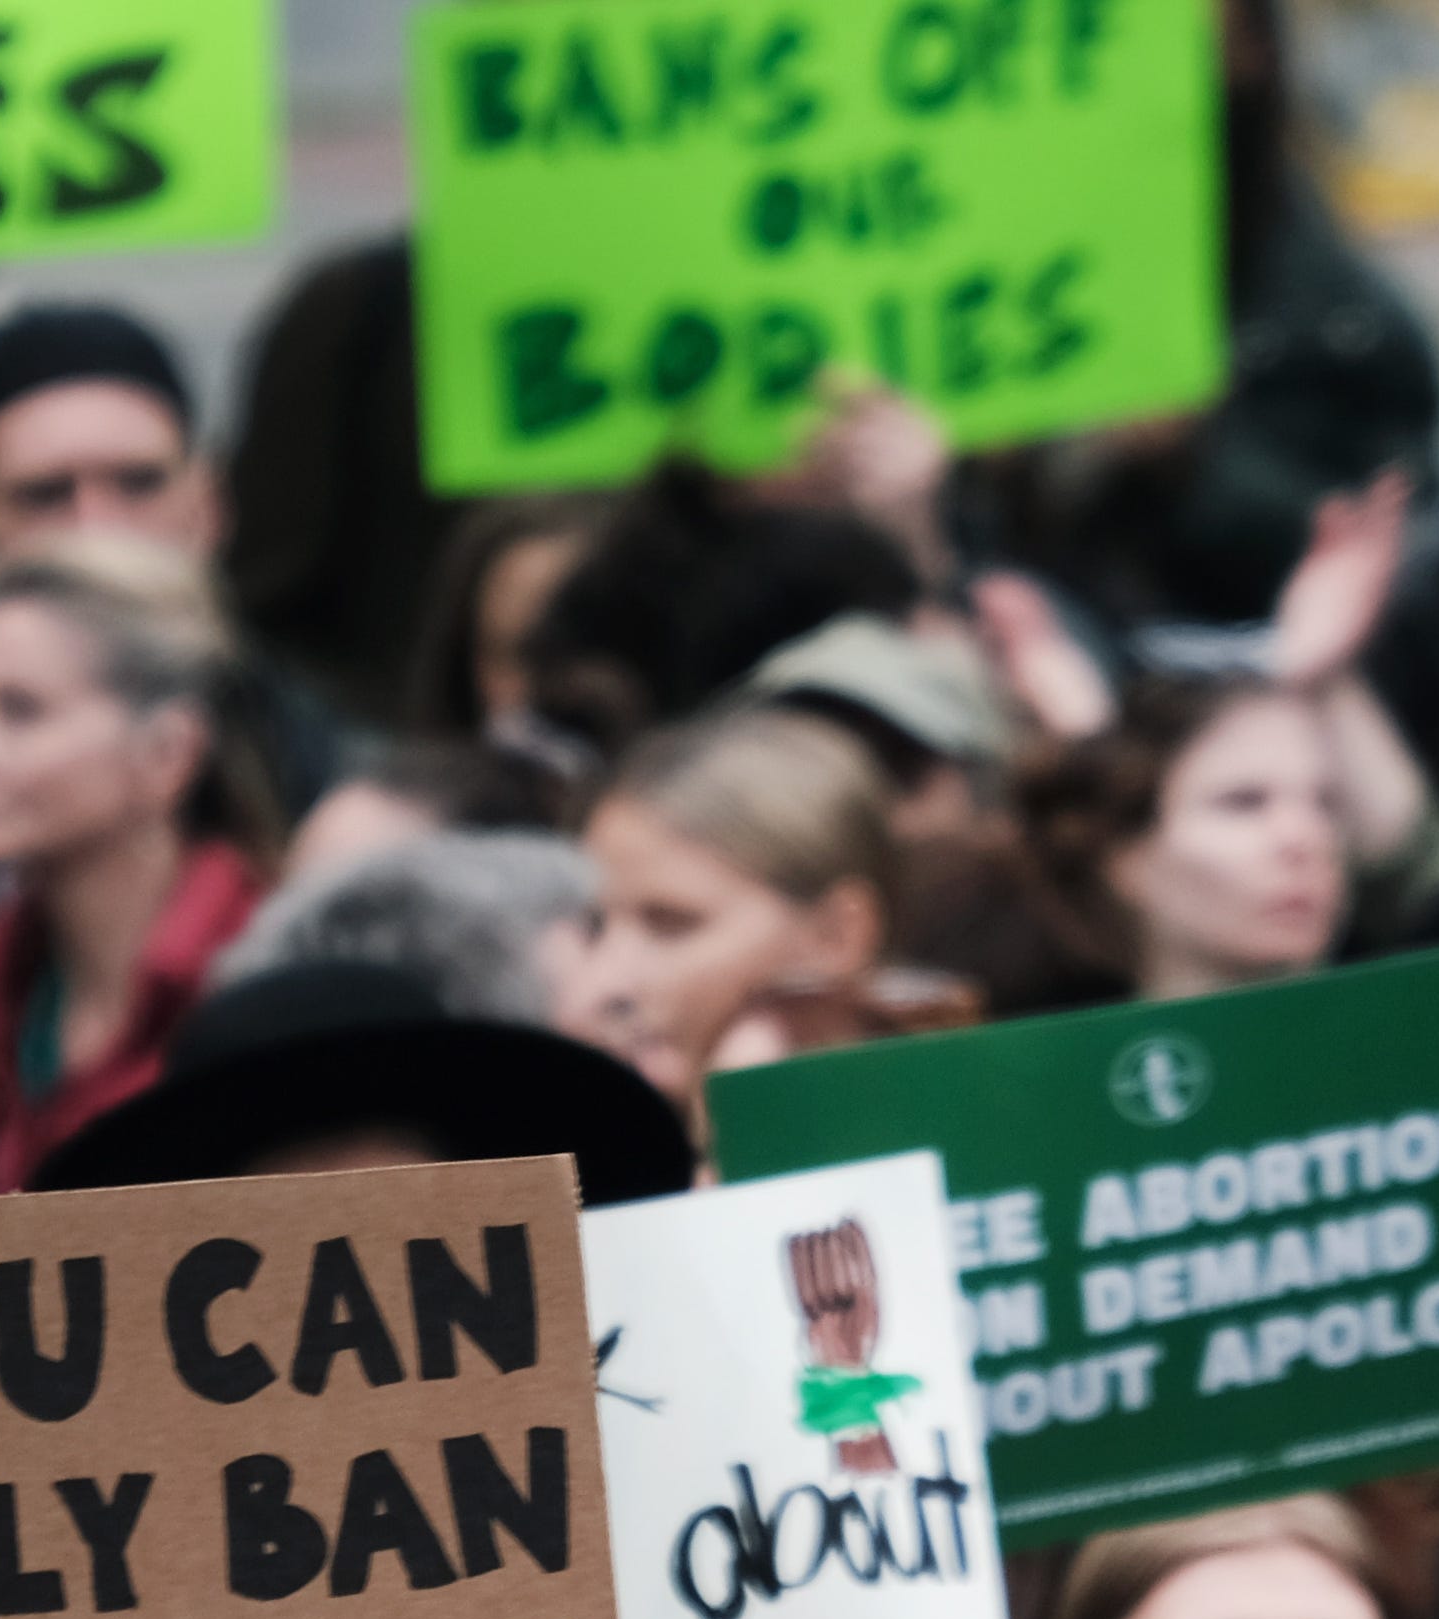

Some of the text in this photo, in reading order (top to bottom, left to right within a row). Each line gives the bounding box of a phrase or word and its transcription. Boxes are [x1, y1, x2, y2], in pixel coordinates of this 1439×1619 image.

[455, 18, 822, 155] BANS
[497, 245, 1102, 445] BODIES
[164, 1223, 539, 1404] CAN
[1080, 1201, 1432, 1336] DEMAND
[224, 1427, 571, 1601] BAN
